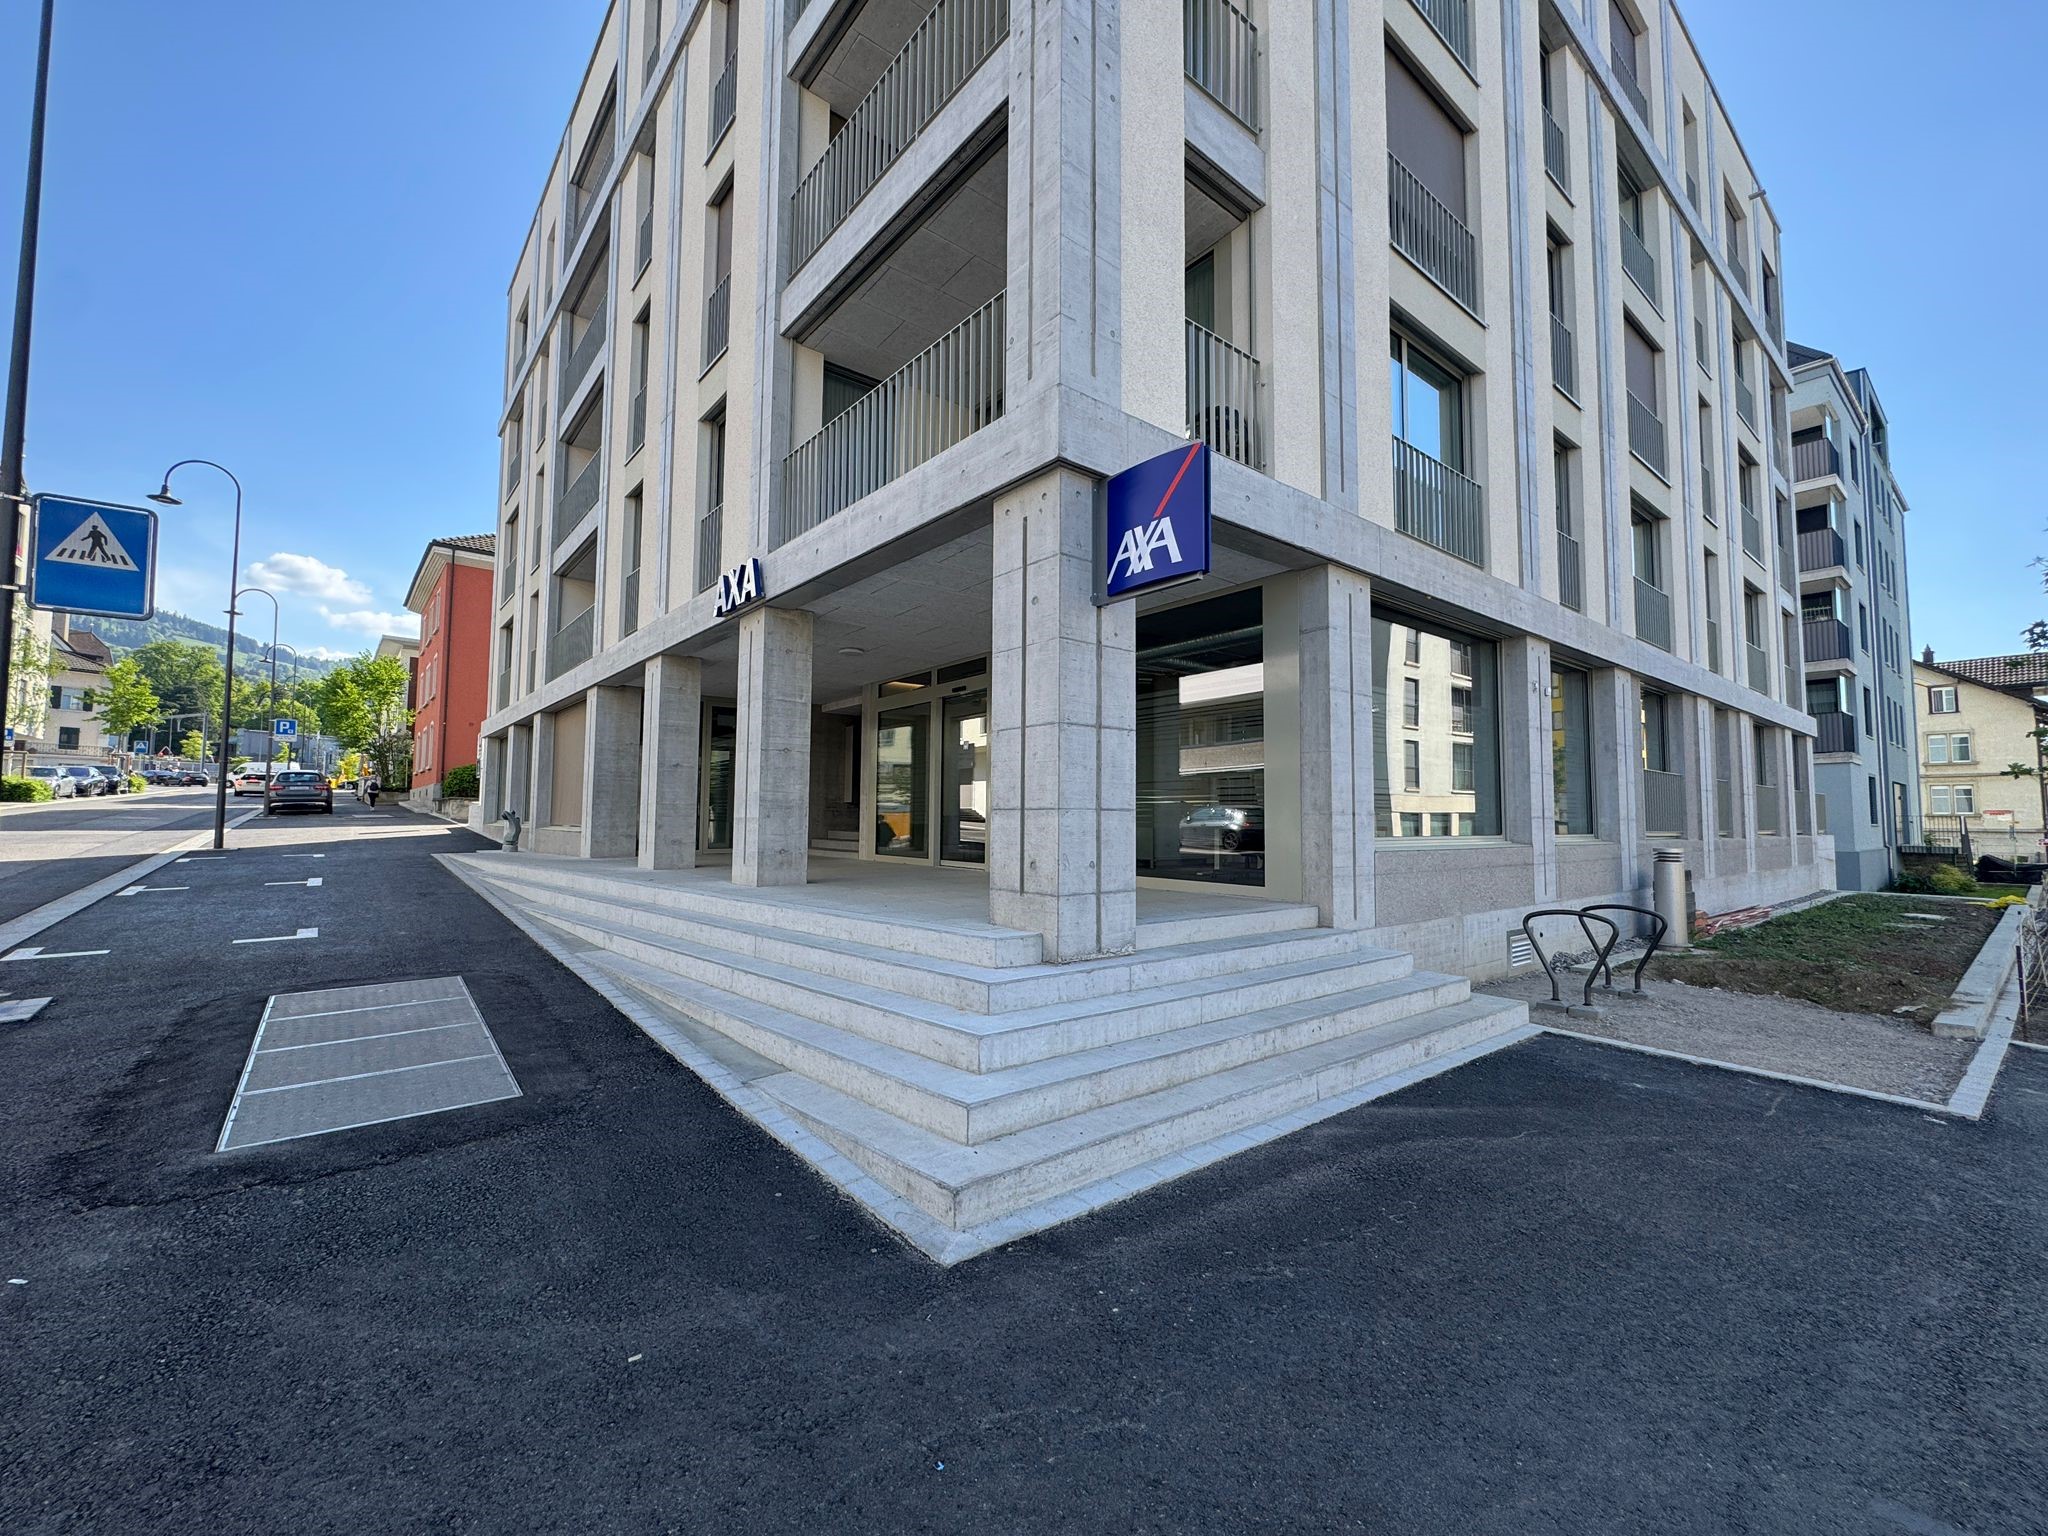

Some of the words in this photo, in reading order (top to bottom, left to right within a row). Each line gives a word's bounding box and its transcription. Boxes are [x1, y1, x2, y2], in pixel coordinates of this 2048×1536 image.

[1107, 516, 1183, 585] AXA
[712, 557, 762, 618] AXA
[279, 721, 290, 733] P
